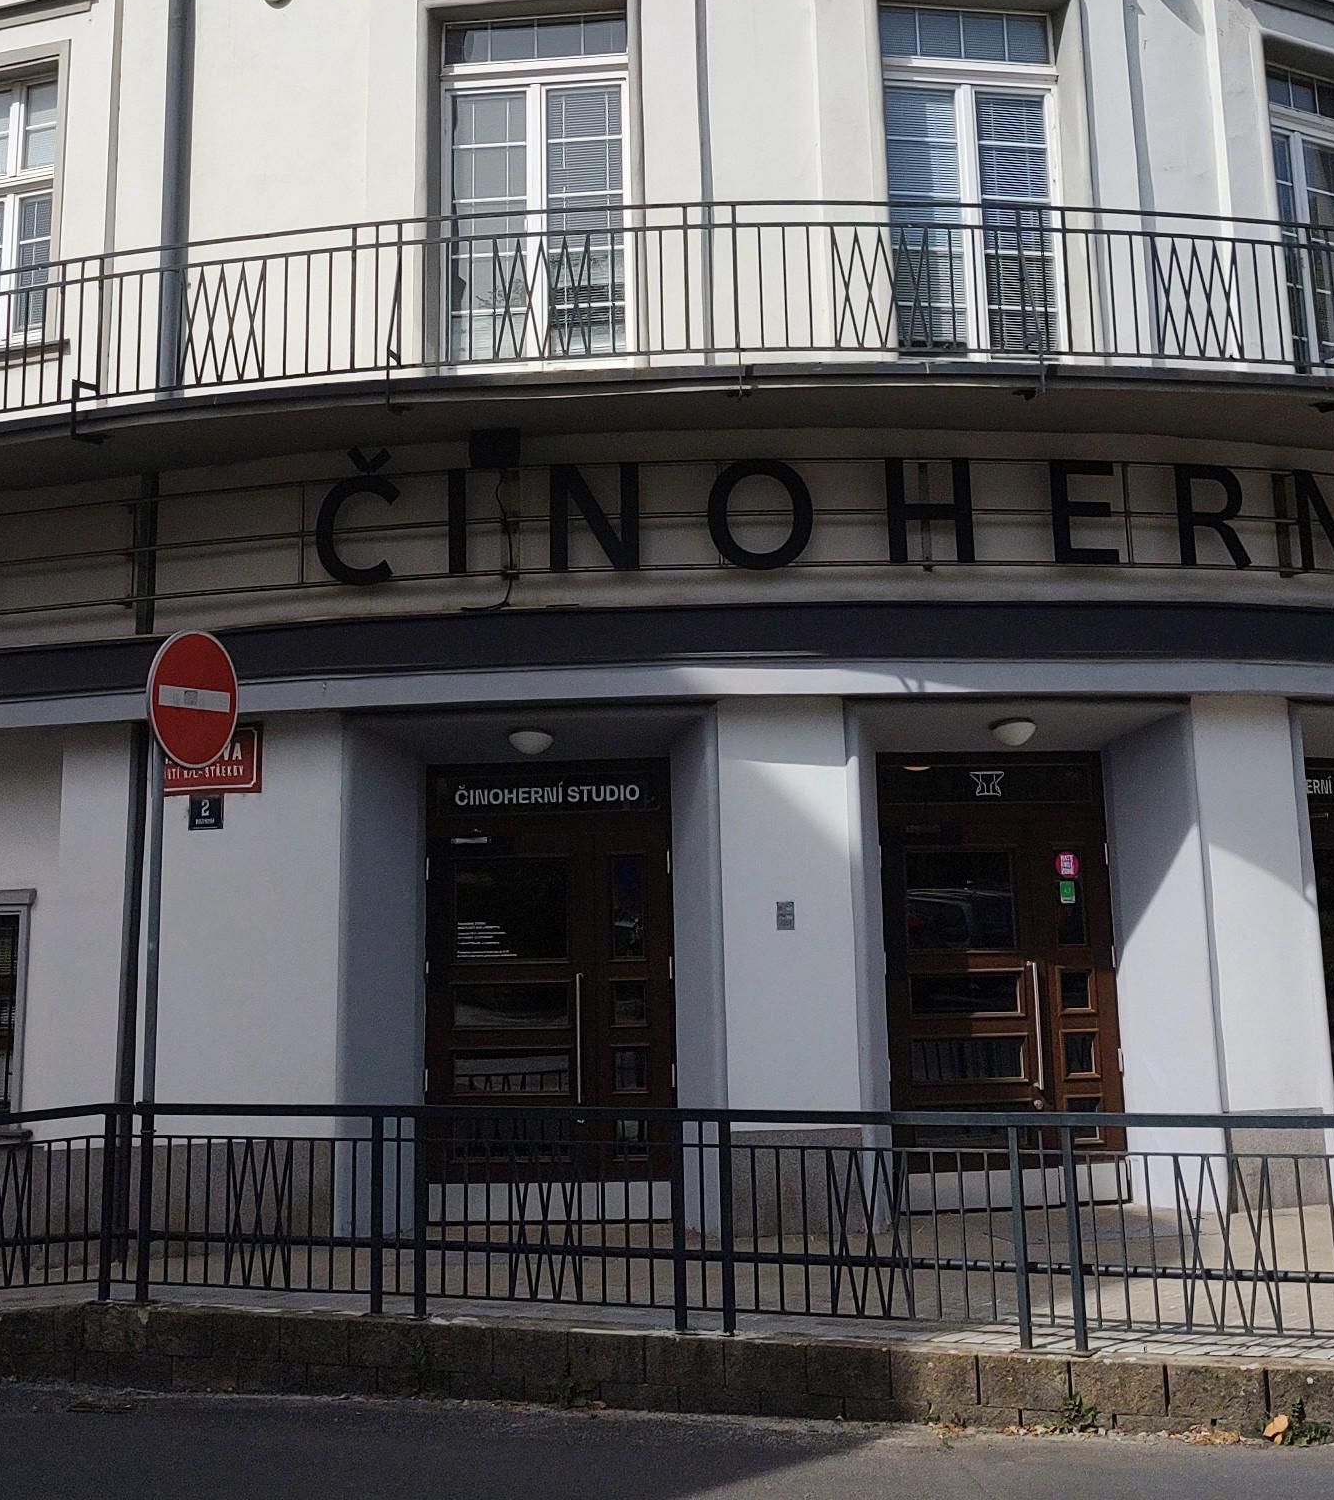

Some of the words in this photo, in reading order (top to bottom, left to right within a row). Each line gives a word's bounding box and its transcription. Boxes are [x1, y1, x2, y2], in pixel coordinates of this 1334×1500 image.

[455, 781, 564, 806] ČINOHERNÍ
[567, 784, 640, 803] STUDIO
[201, 799, 210, 817] 2
